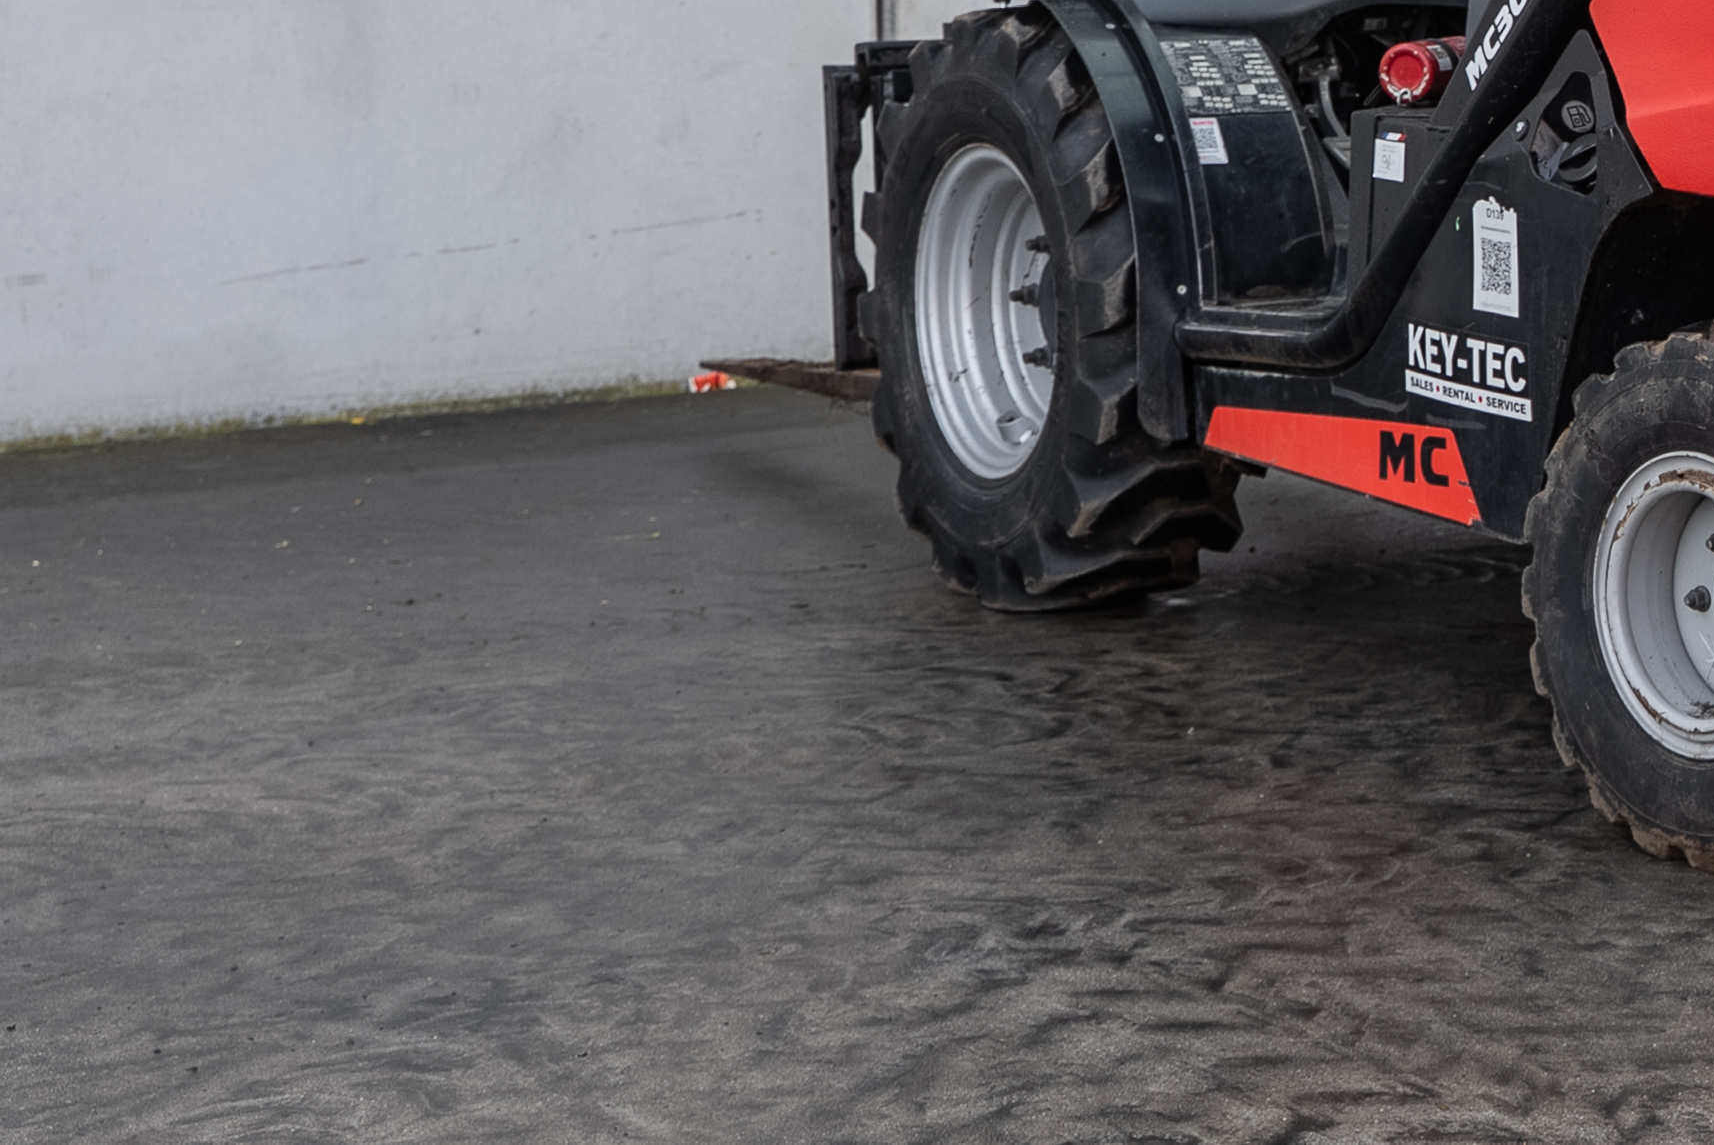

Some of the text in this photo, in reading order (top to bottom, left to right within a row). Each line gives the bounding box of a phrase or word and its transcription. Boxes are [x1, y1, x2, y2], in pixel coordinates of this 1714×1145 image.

[1408, 323, 1527, 393] KEY-TEC
[1410, 376, 1527, 415] SALES RENTAL SERVICE
[1379, 430, 1449, 487] MC
